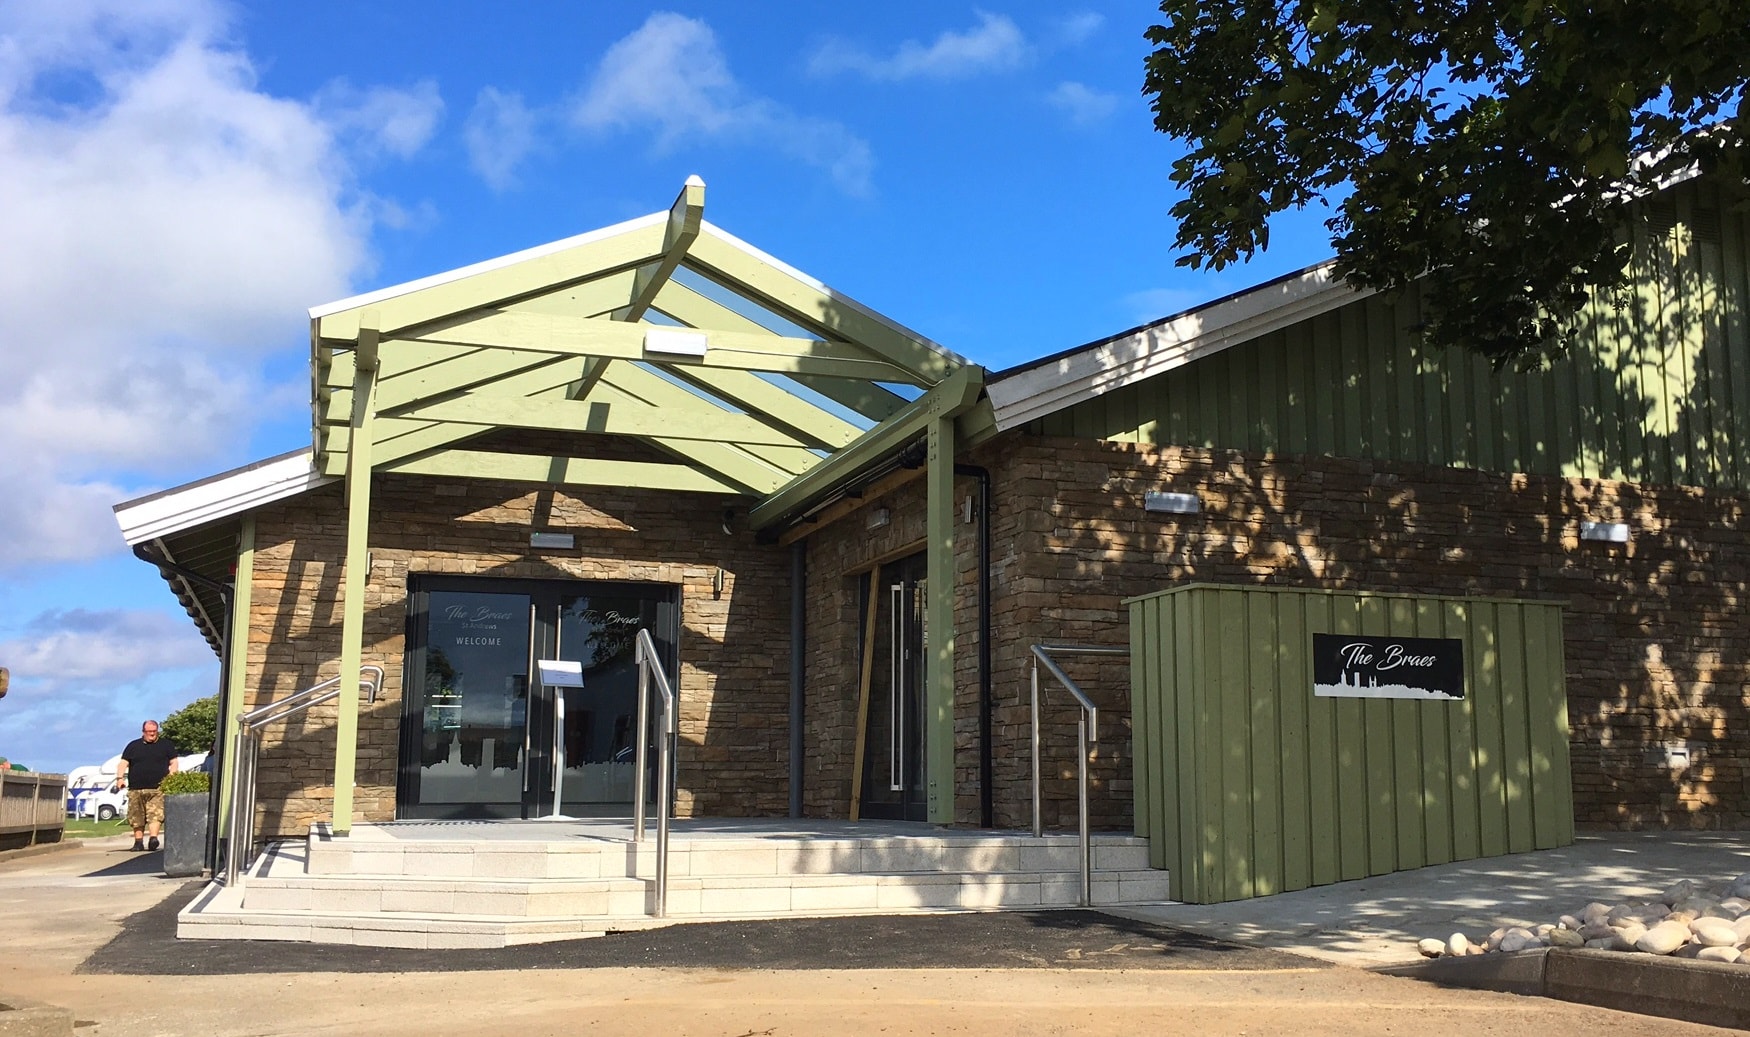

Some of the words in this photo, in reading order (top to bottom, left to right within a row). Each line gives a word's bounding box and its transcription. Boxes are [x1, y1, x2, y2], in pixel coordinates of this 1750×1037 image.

[445, 605, 468, 620] The
[470, 606, 512, 622] Braes
[603, 610, 640, 626] Braes
[456, 637, 502, 646] WELCOME
[1340, 642, 1374, 669] The
[1376, 644, 1437, 671] Braes
